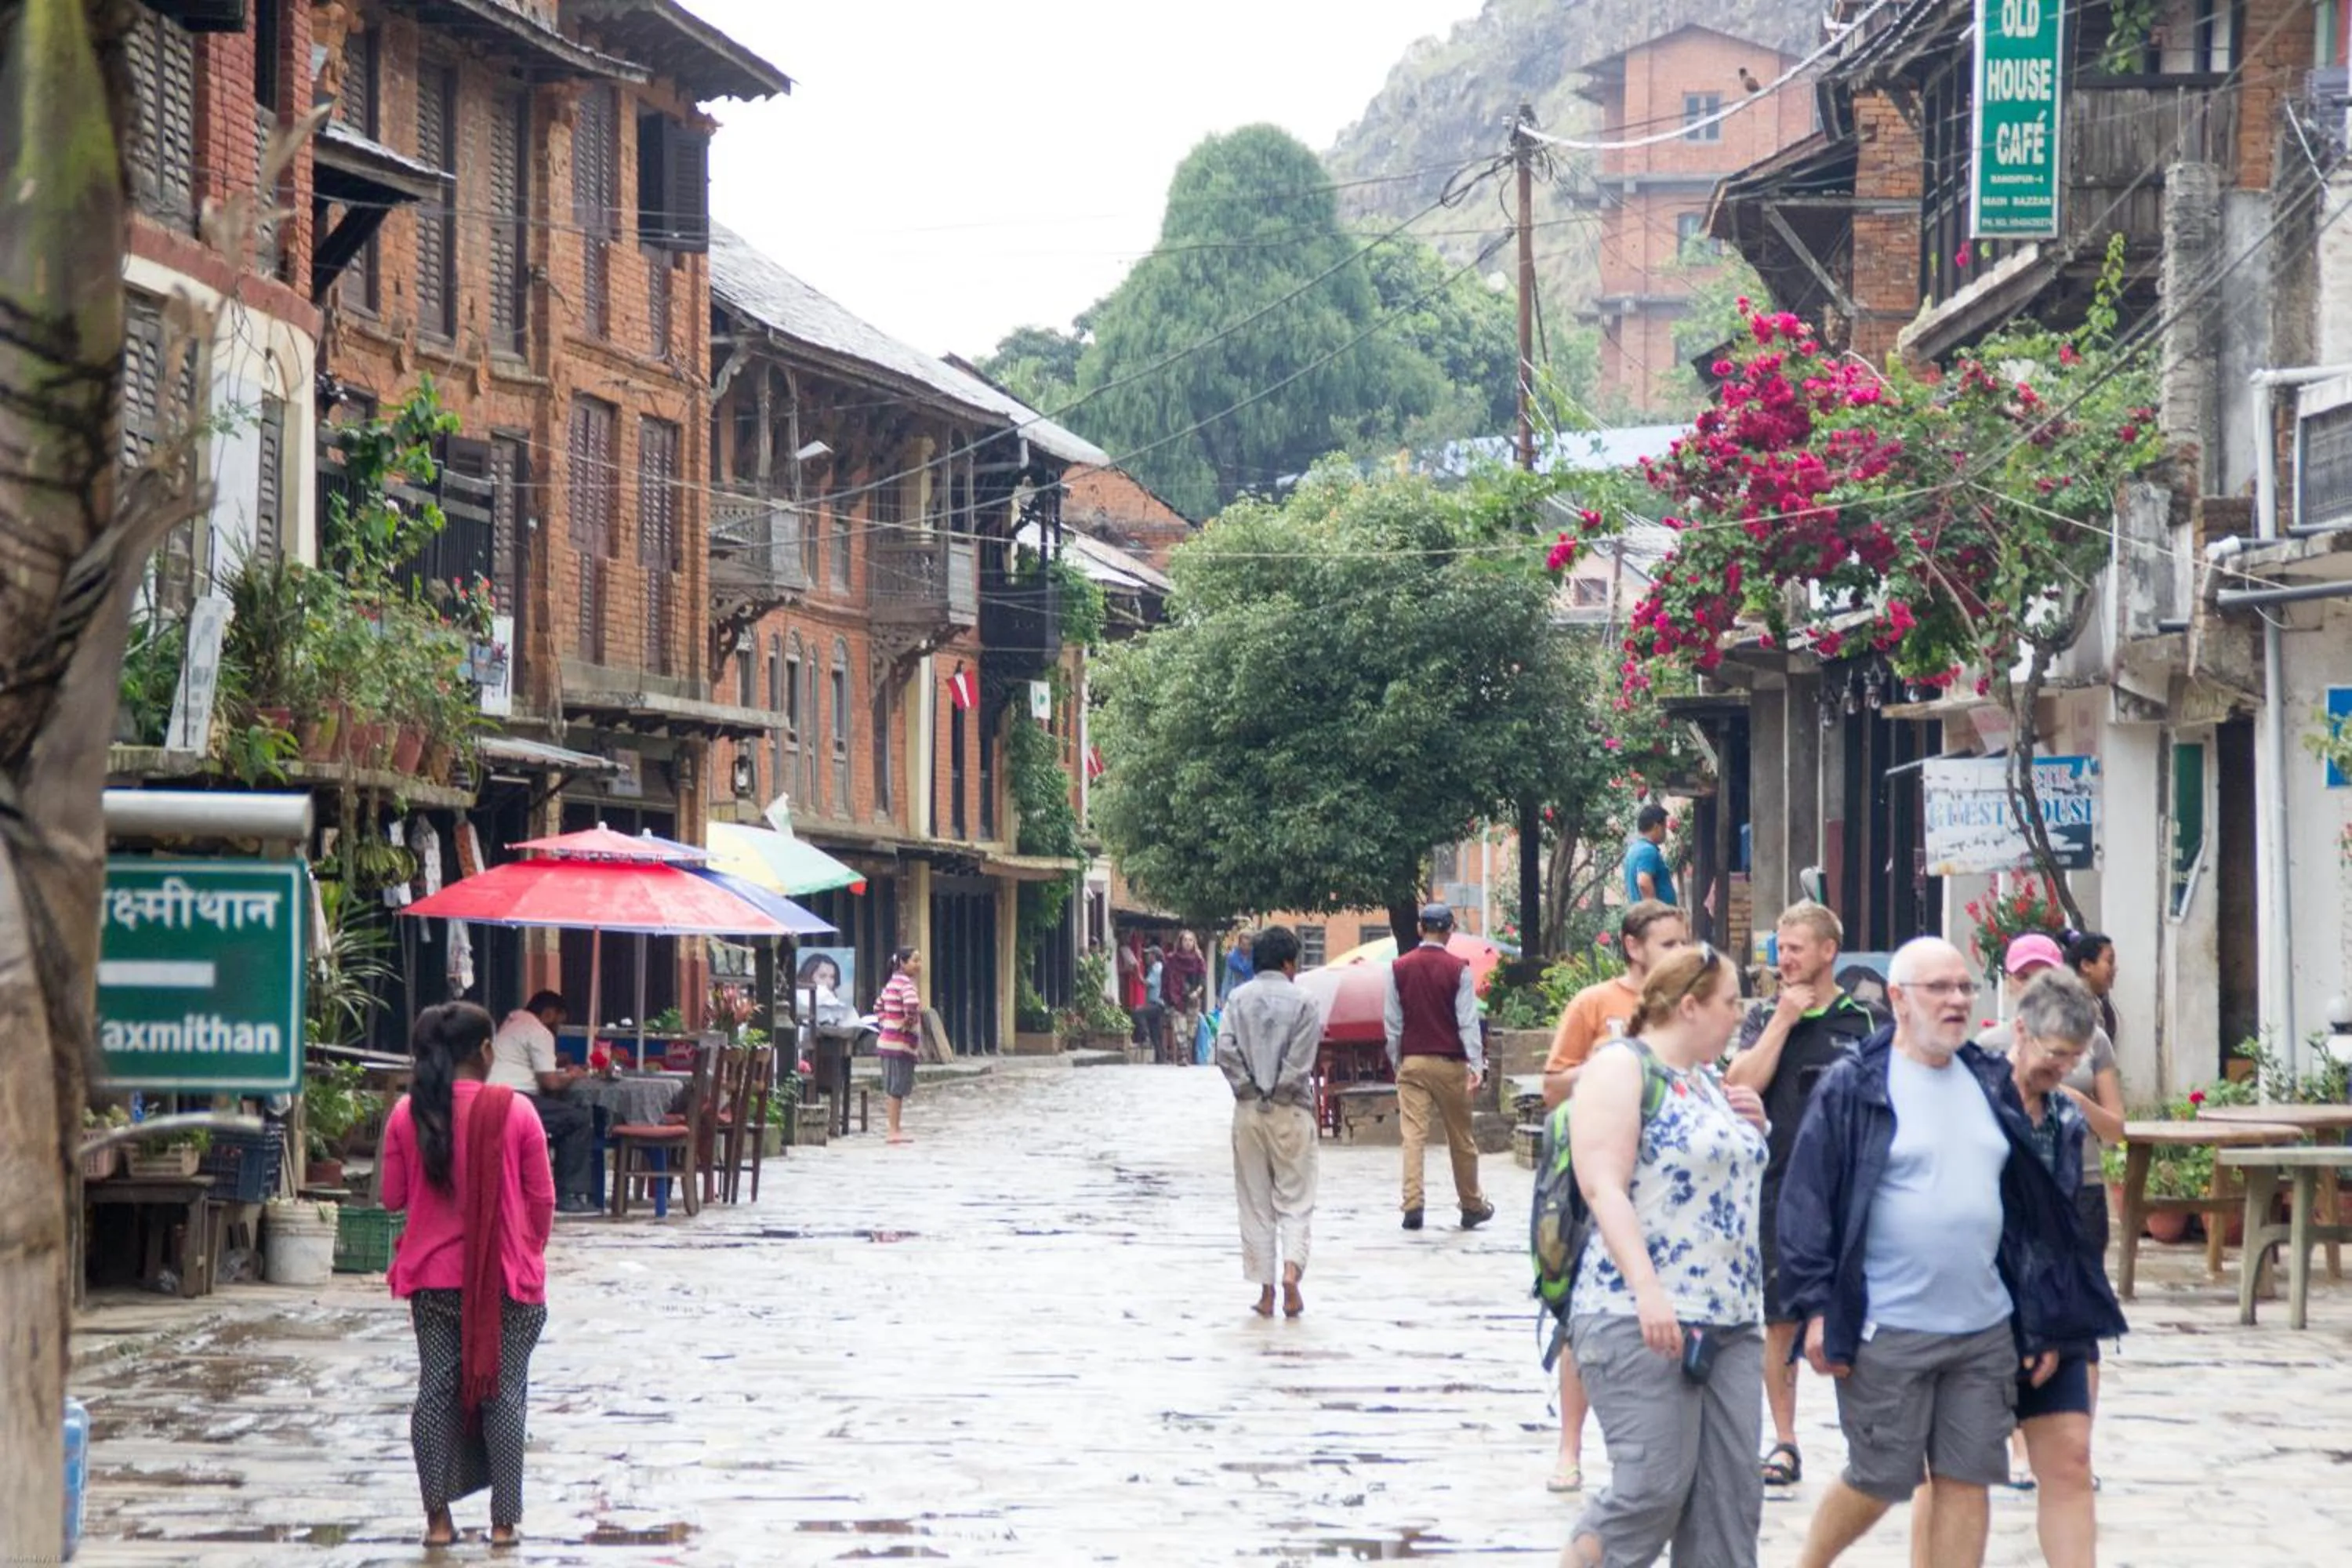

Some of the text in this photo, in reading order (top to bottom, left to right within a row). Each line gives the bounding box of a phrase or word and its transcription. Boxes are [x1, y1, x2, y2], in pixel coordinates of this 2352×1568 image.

[2002, 0, 2040, 38] OLD
[1987, 58, 2053, 101] HOUSE
[1996, 110, 2047, 165] CAFÉ
[100, 1014, 281, 1053] axmithan
